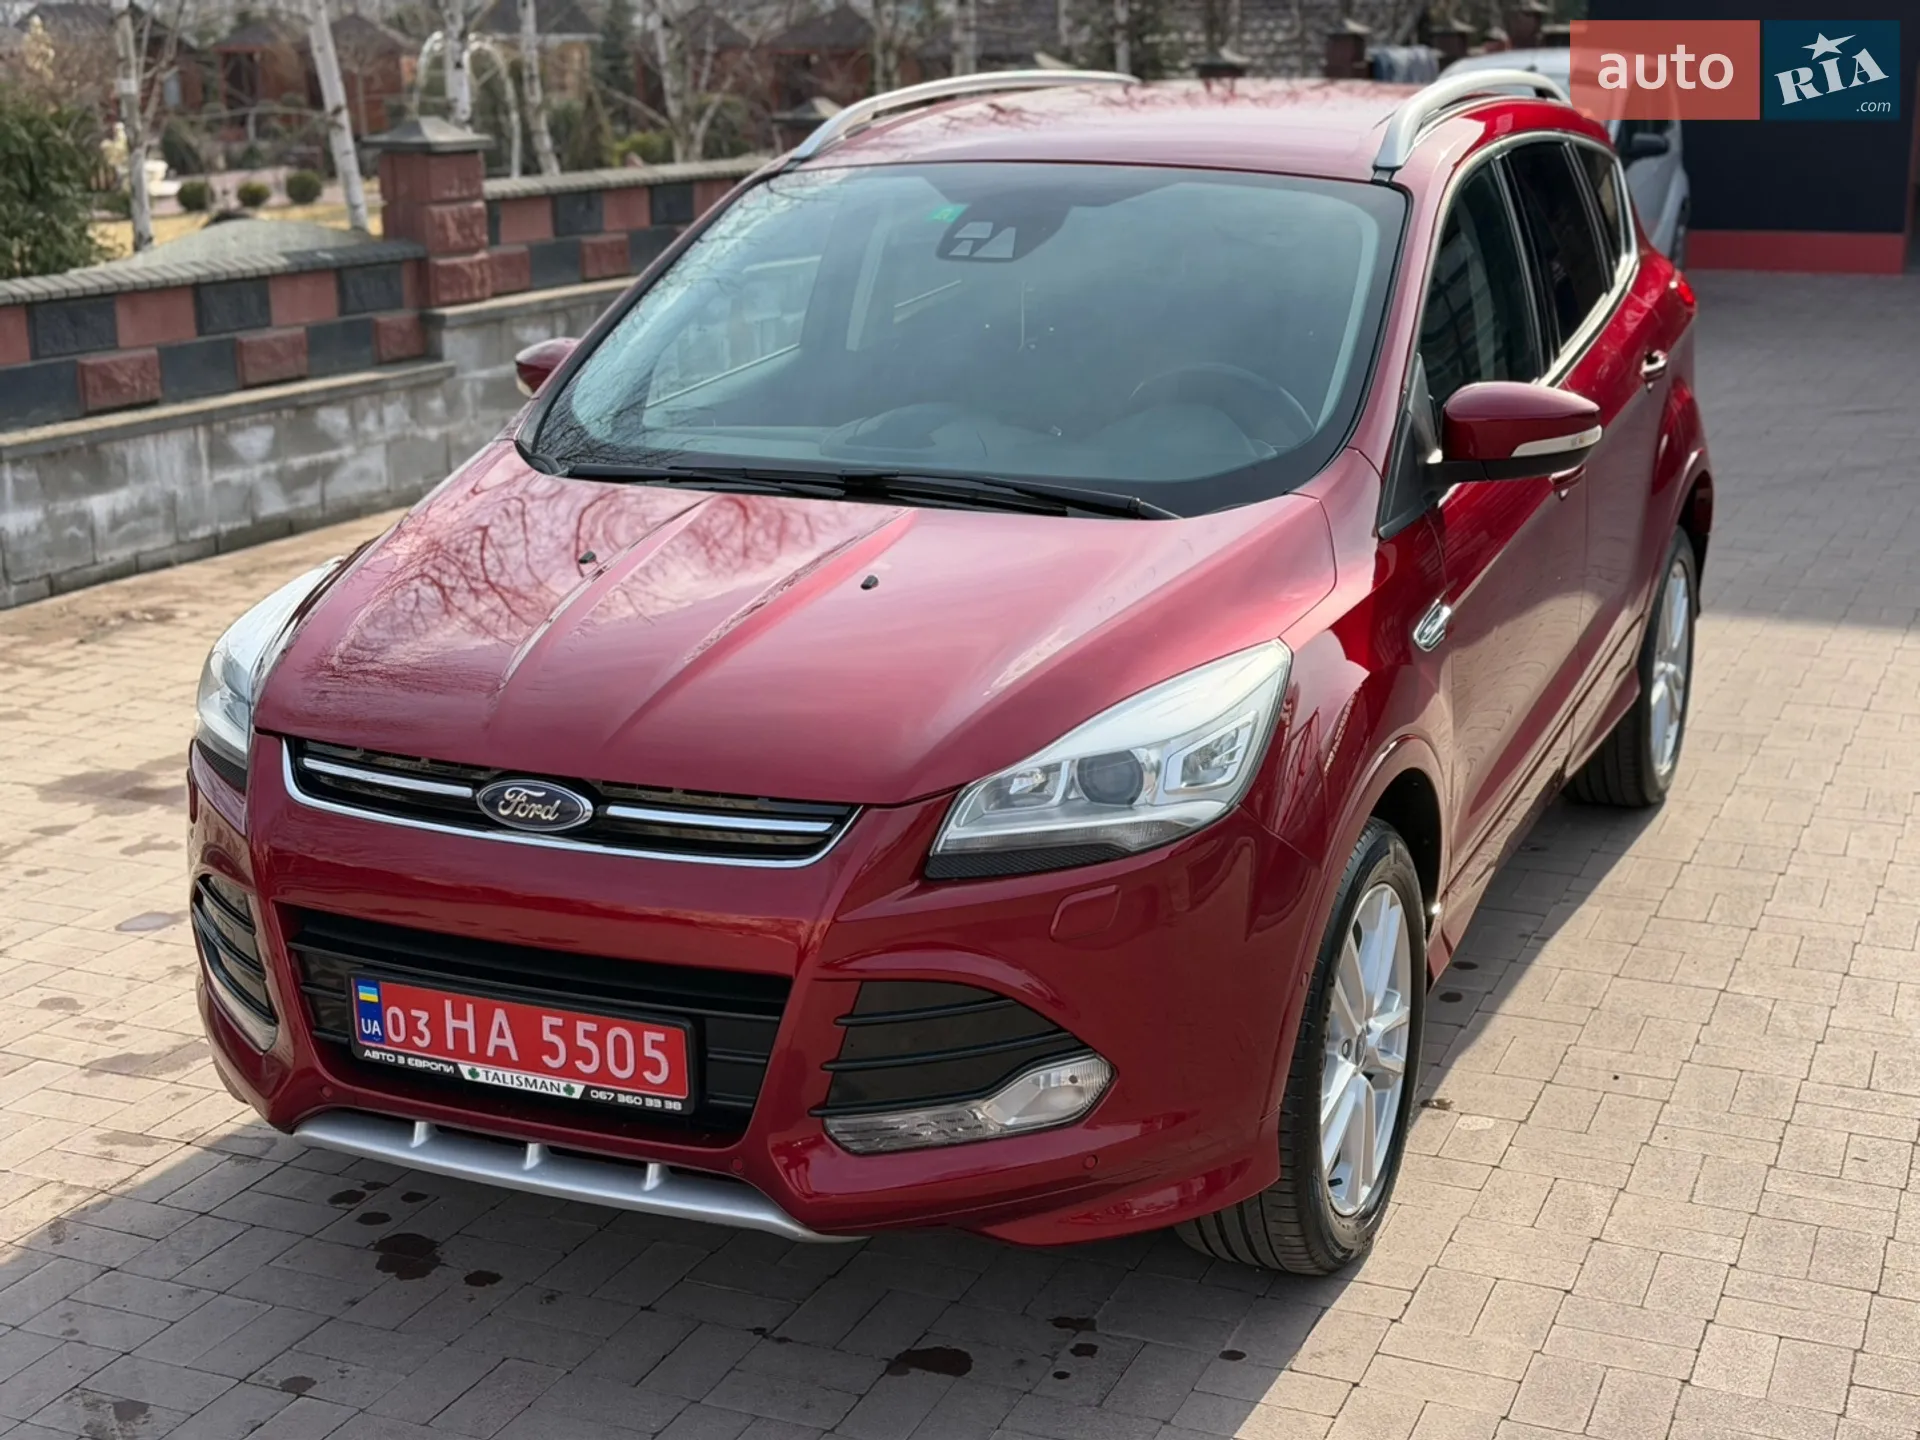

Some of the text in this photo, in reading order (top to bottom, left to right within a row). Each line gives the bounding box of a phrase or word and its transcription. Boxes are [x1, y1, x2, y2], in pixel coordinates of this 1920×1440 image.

[497, 786, 562, 821] Ford
[361, 1016, 383, 1037] UA
[386, 999, 670, 1085] 03 HA 5505
[363, 1049, 396, 1063] АВТО
[482, 1069, 562, 1095] TALISMAN
[590, 1089, 615, 1101] 067
